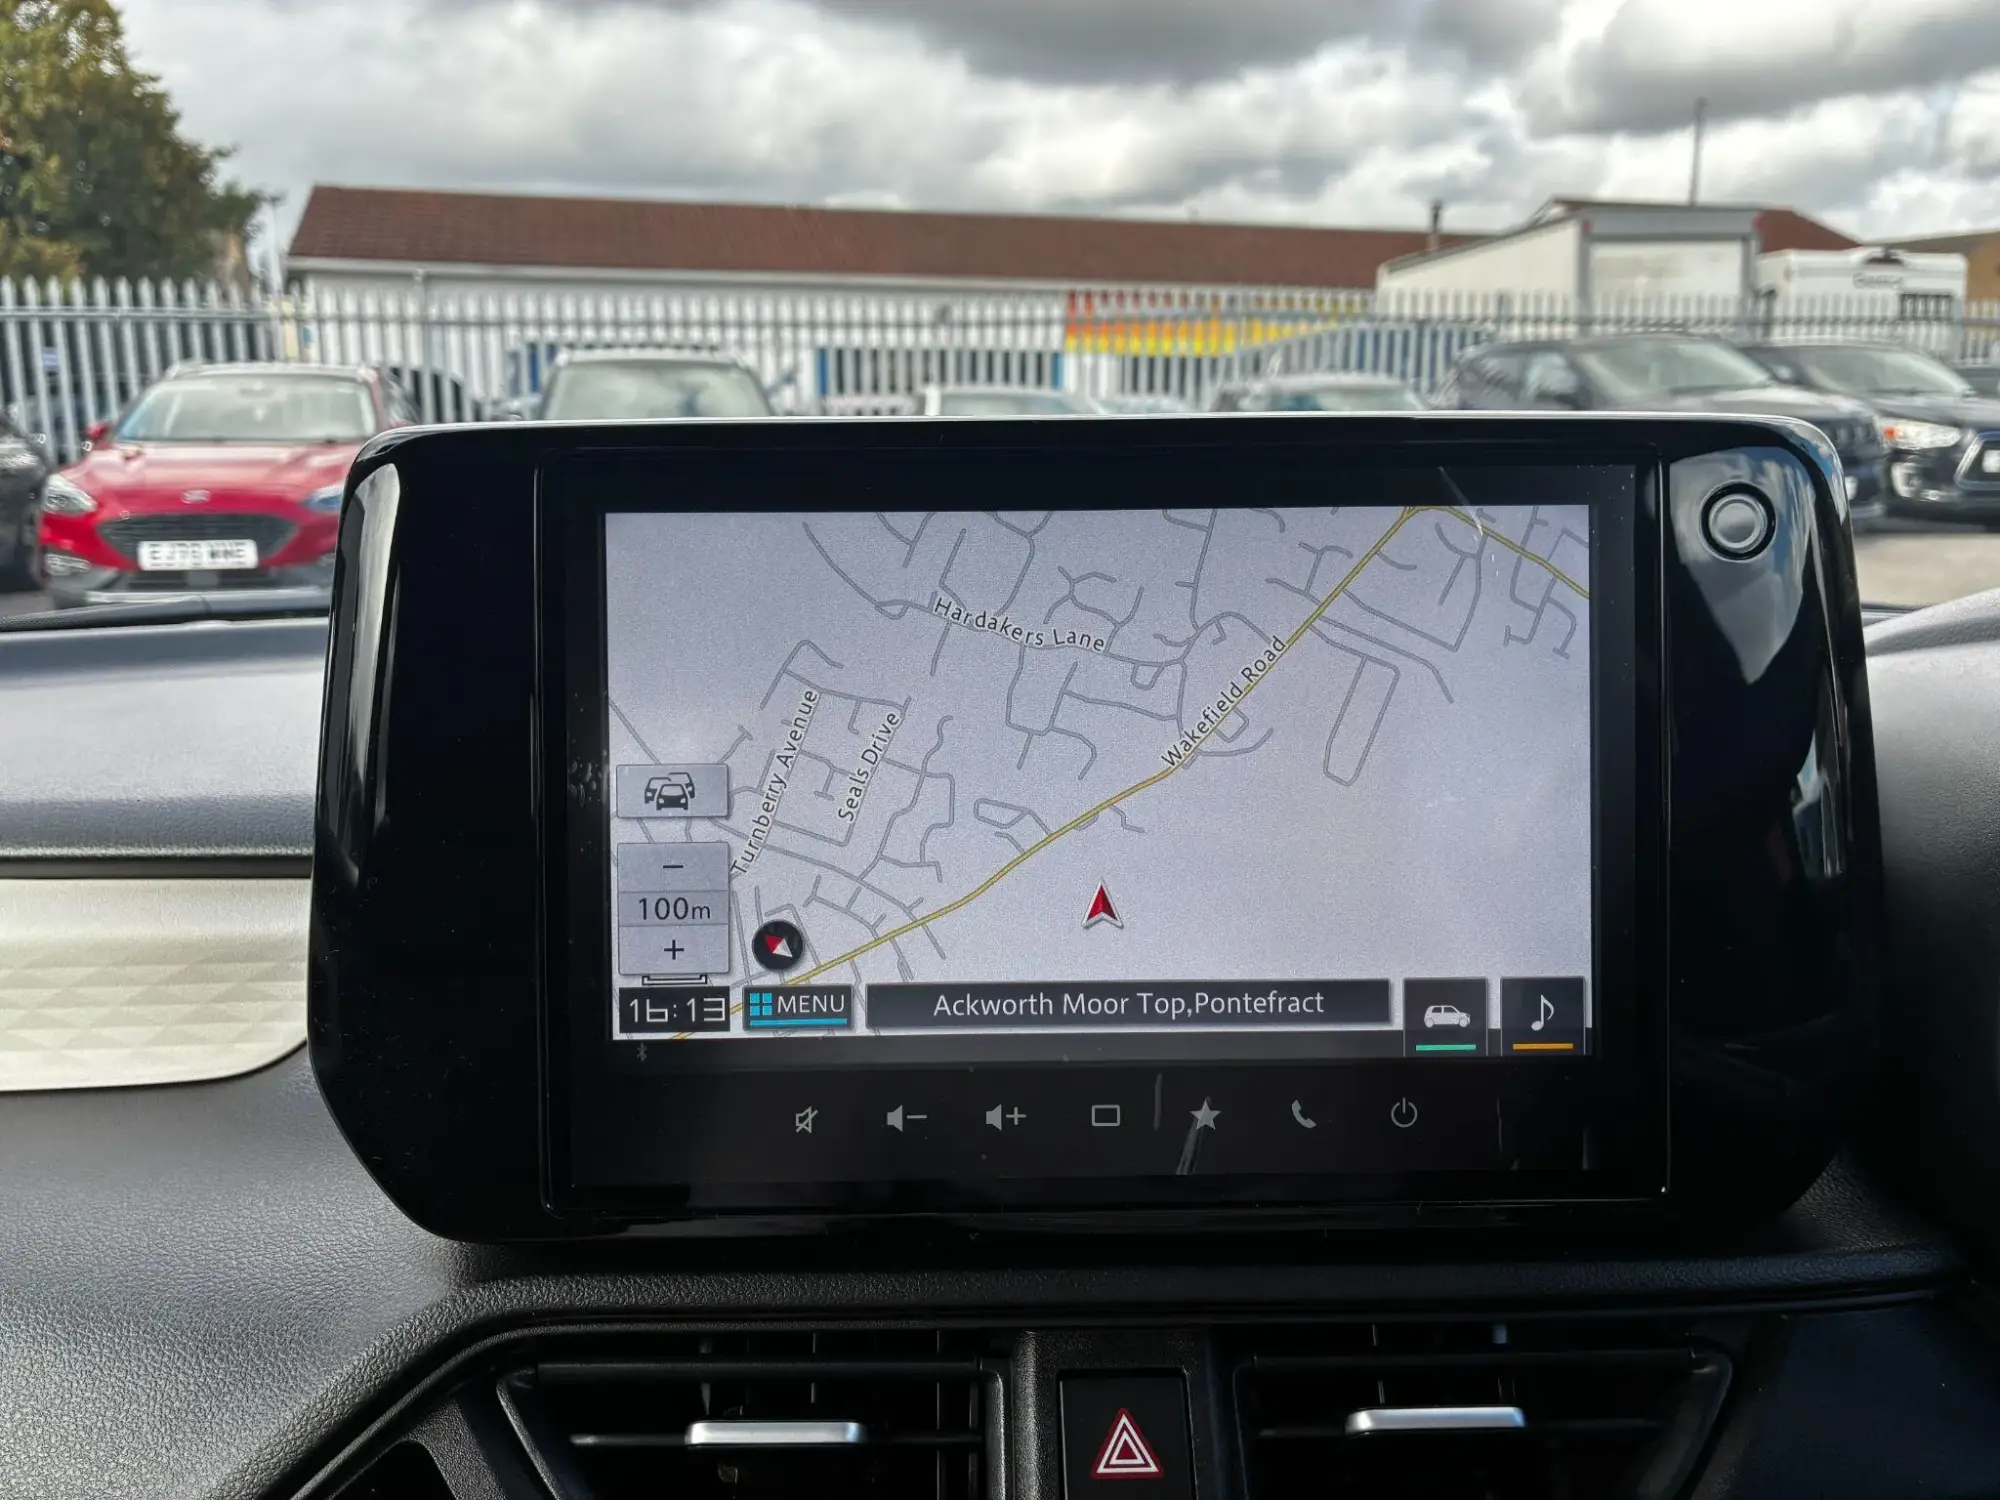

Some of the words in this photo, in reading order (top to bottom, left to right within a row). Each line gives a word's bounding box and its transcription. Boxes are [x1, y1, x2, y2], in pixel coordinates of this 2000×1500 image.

[934, 597, 1044, 646] Hardakers
[1053, 628, 1104, 651] Lane
[1161, 681, 1243, 767] Wakefield
[1240, 635, 1286, 684] Road
[730, 773, 787, 873] Turnberry
[776, 690, 817, 768] Avenue
[838, 768, 869, 822] Seals
[861, 712, 899, 765] Drive
[638, 897, 711, 921] 100m
[629, 996, 726, 1024] 16:13
[777, 994, 845, 1014] MENU
[933, 992, 1053, 1017] Ackworth
[1062, 993, 1129, 1015] Moor
